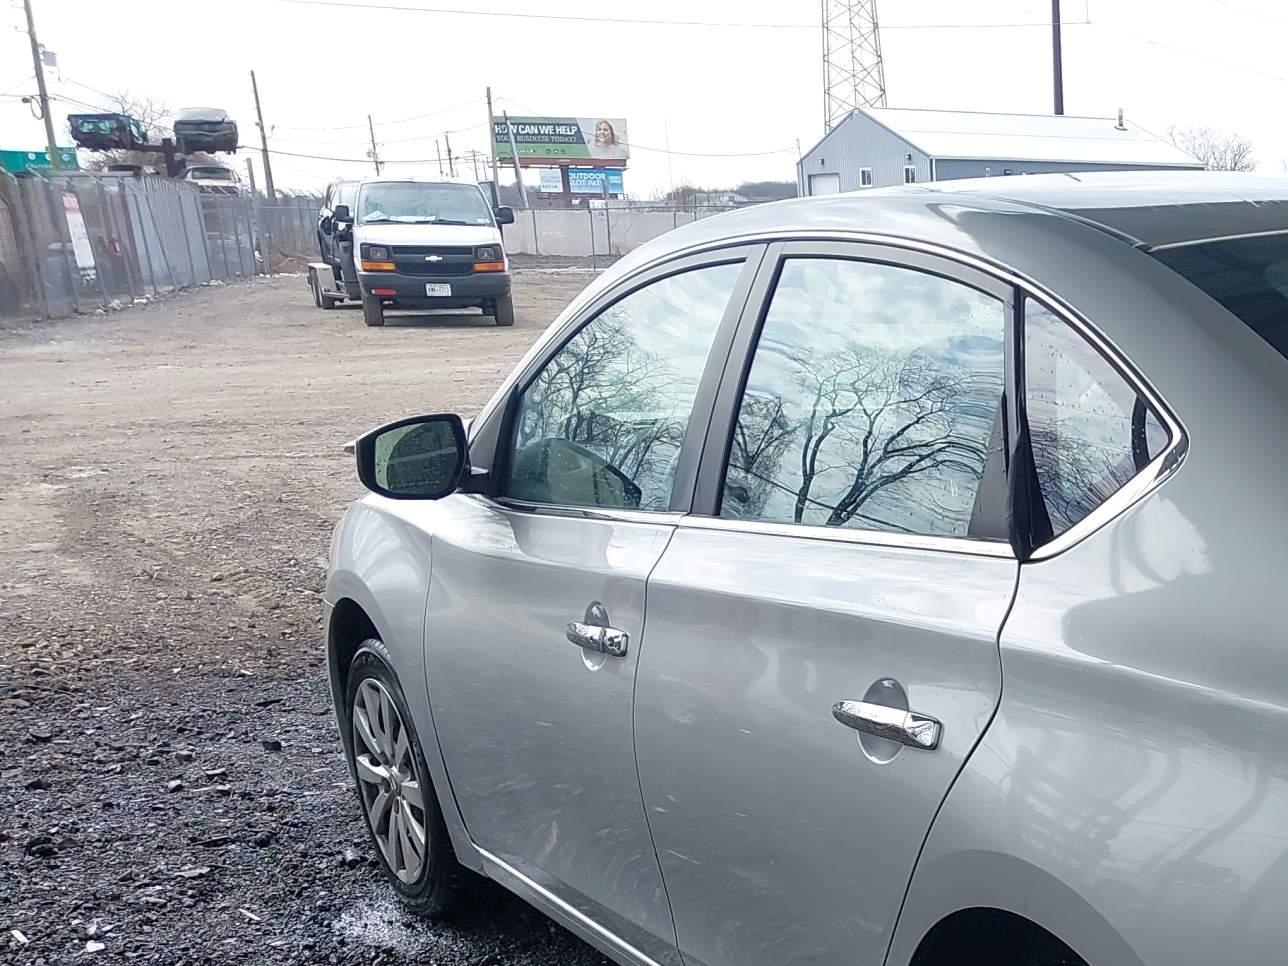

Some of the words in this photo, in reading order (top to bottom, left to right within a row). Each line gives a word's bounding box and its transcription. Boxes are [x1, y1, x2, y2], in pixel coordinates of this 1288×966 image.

[518, 125, 540, 135] CAN
[540, 125, 555, 135] WE
[555, 125, 577, 135] HELP
